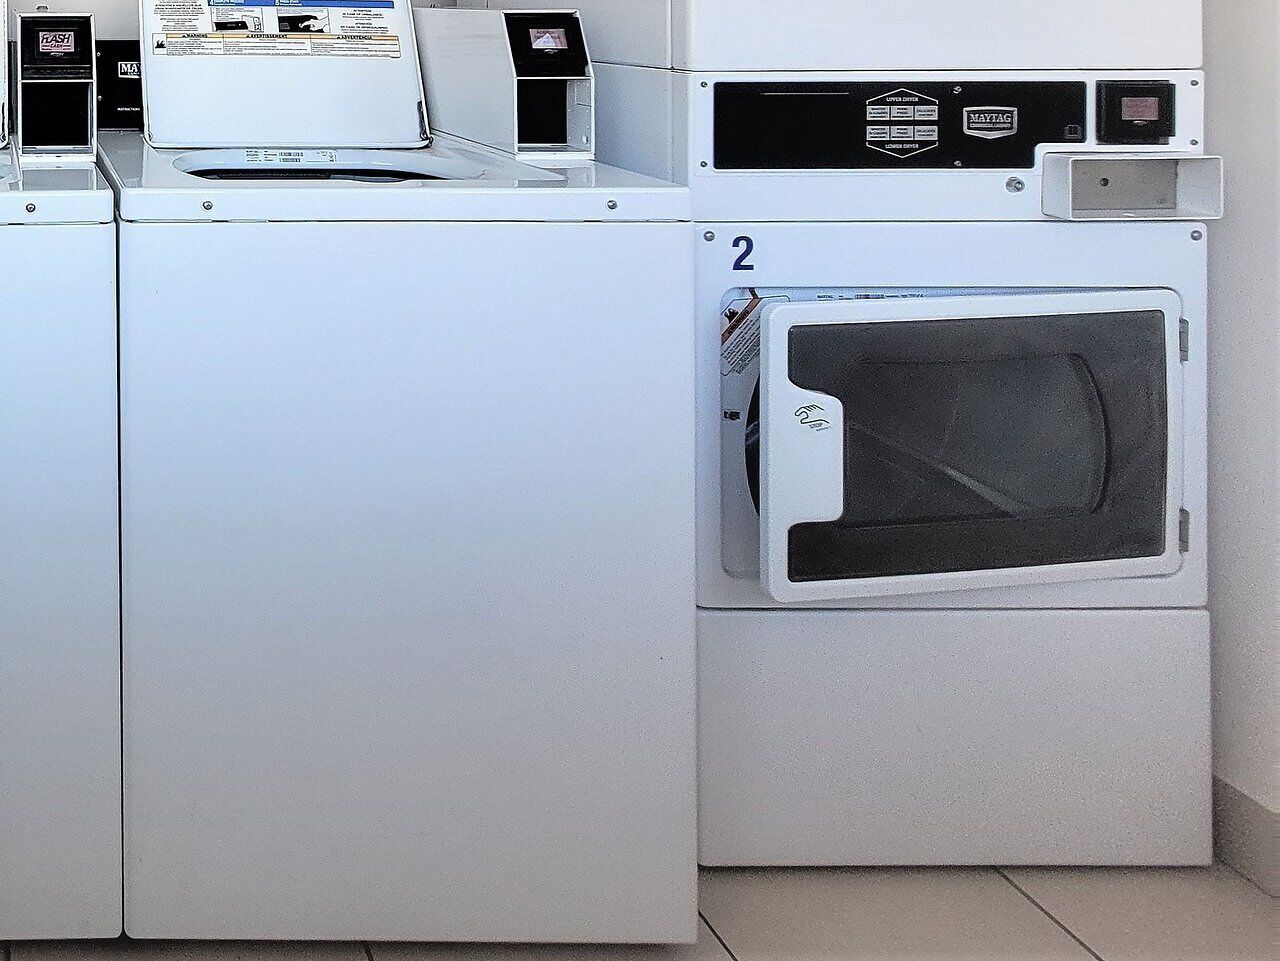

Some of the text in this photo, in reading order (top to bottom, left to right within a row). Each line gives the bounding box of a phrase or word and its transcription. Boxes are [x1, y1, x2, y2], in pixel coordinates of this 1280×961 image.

[41, 33, 71, 43] FLASH
[968, 113, 1012, 122] MAYTAG
[732, 236, 754, 270] 2
